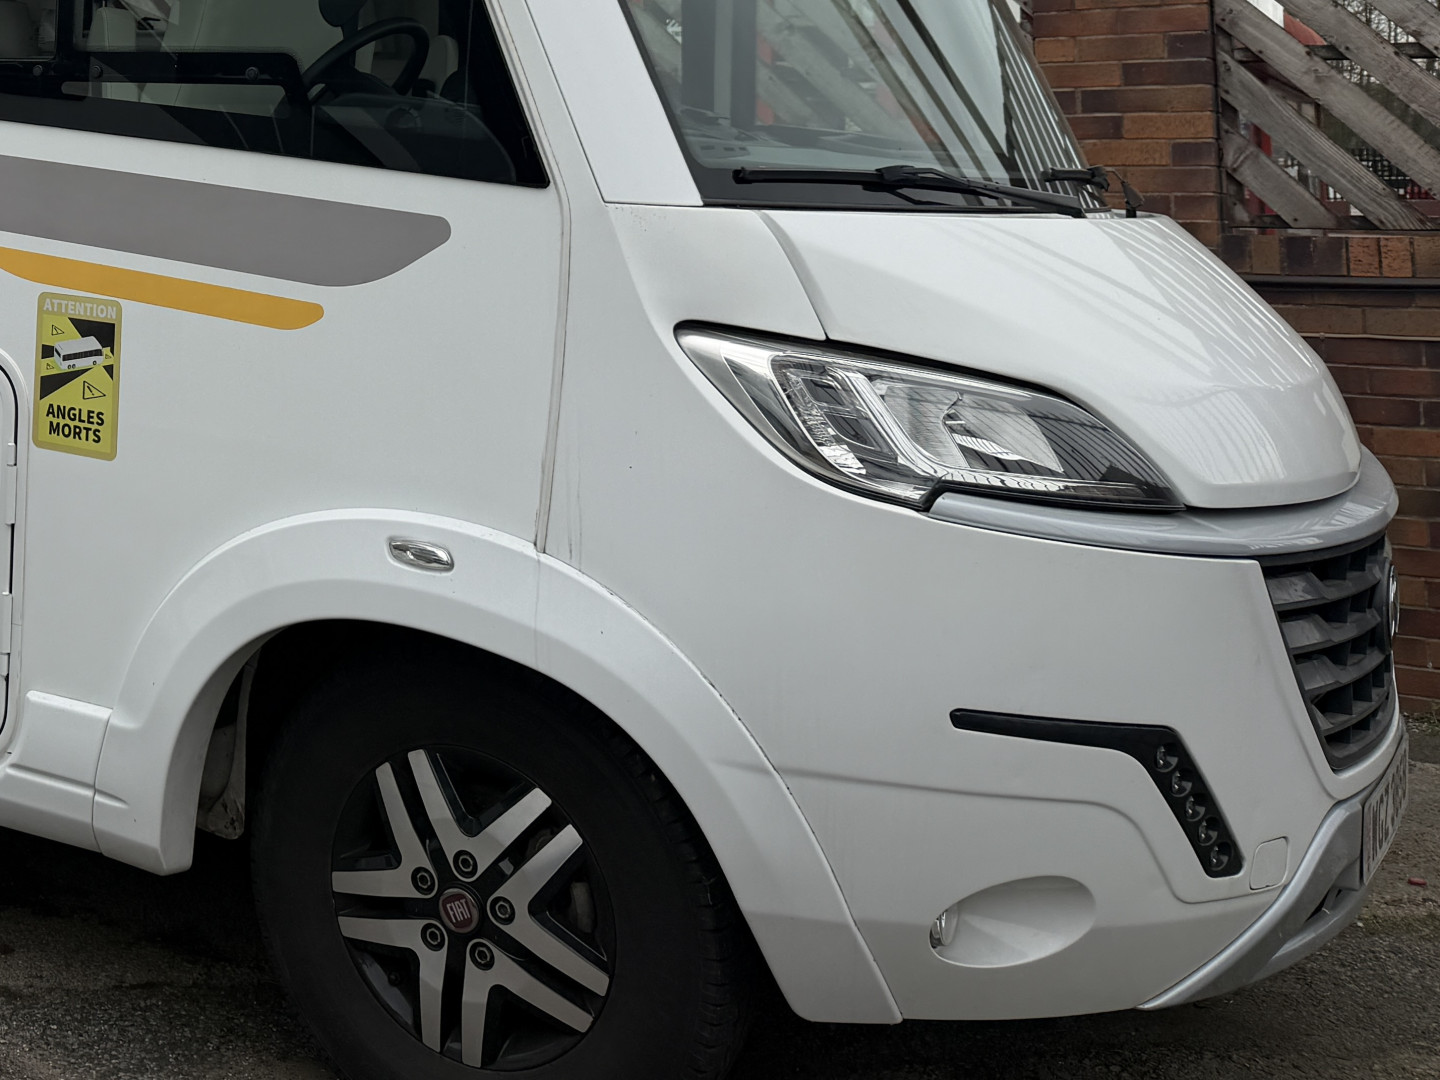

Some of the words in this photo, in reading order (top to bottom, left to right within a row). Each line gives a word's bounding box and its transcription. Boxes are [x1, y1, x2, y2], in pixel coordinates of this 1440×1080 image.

[43, 298, 117, 319] ATTENTION
[46, 403, 105, 427] ANGLES
[48, 420, 102, 444] MORTS
[446, 899, 471, 923] FIAT
